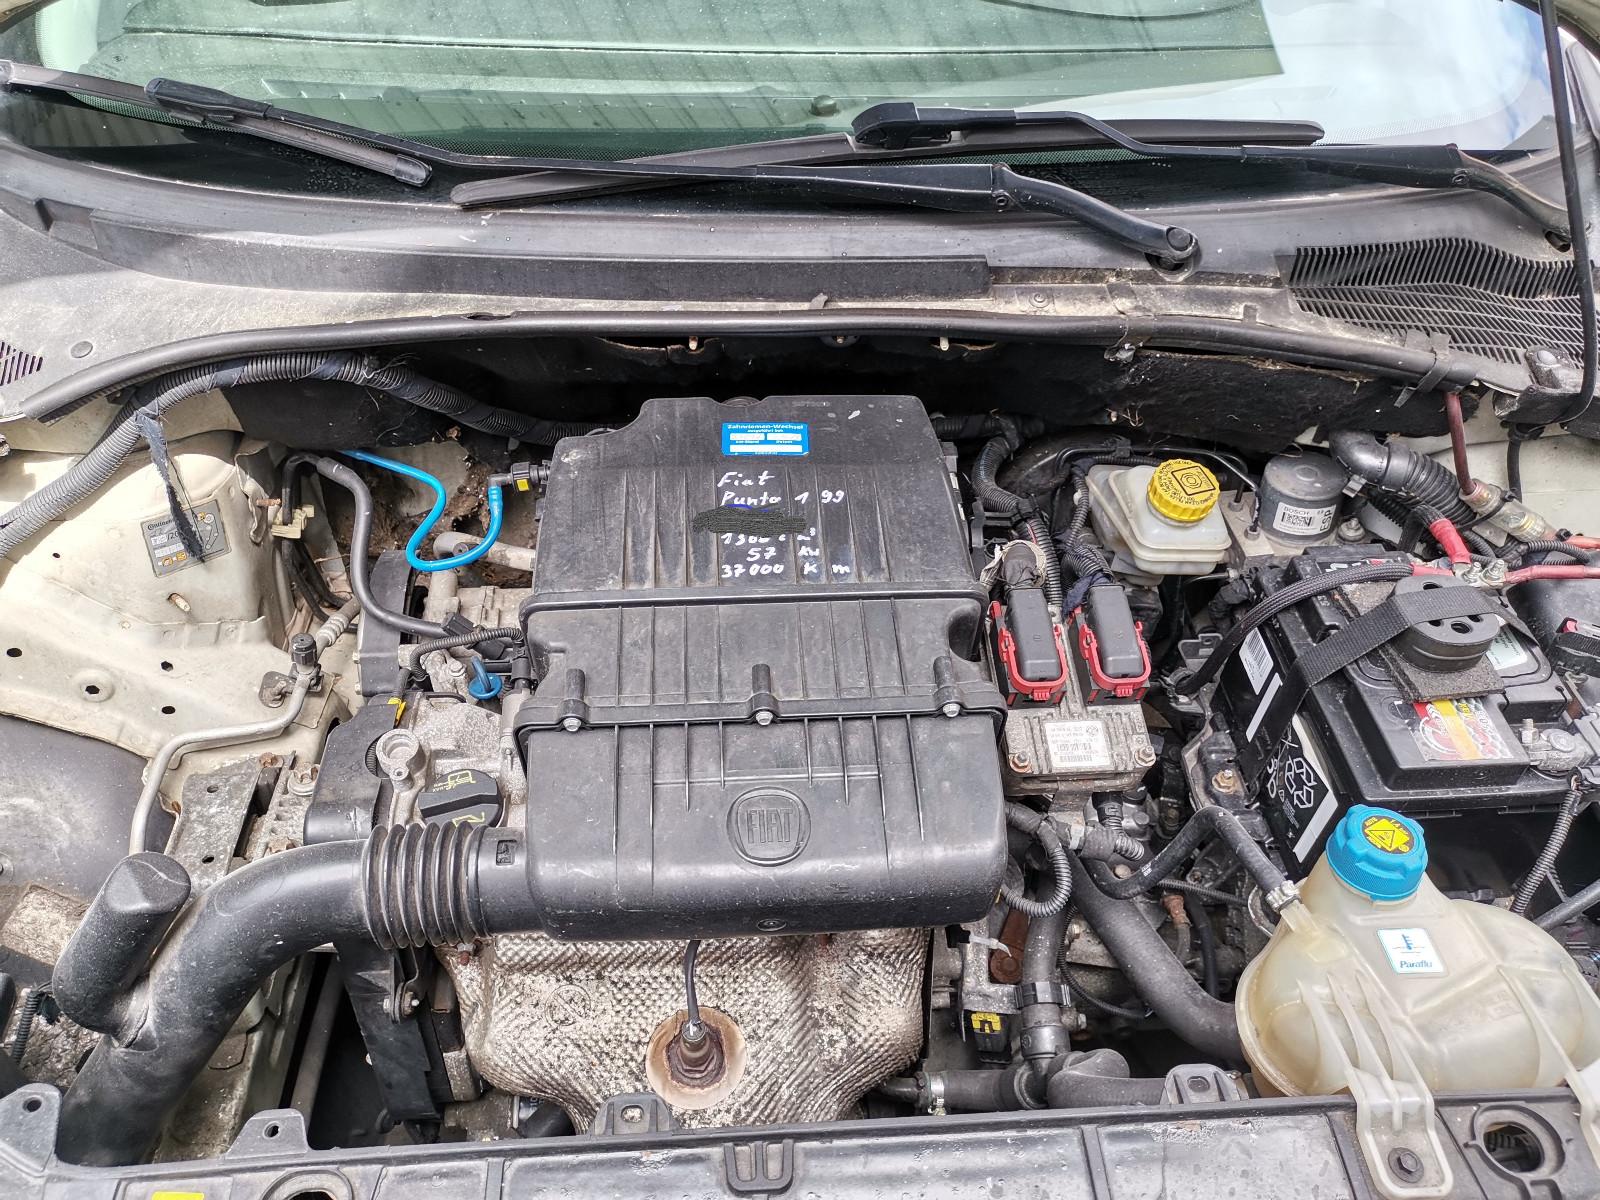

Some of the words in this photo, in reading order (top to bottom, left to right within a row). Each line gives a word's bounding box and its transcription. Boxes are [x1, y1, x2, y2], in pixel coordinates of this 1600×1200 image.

[717, 470, 775, 487] Fiat
[720, 490, 781, 506] Punto
[746, 546, 777, 561] 57
[746, 807, 794, 844] FIAT
[1399, 960, 1433, 969] Paraflu
